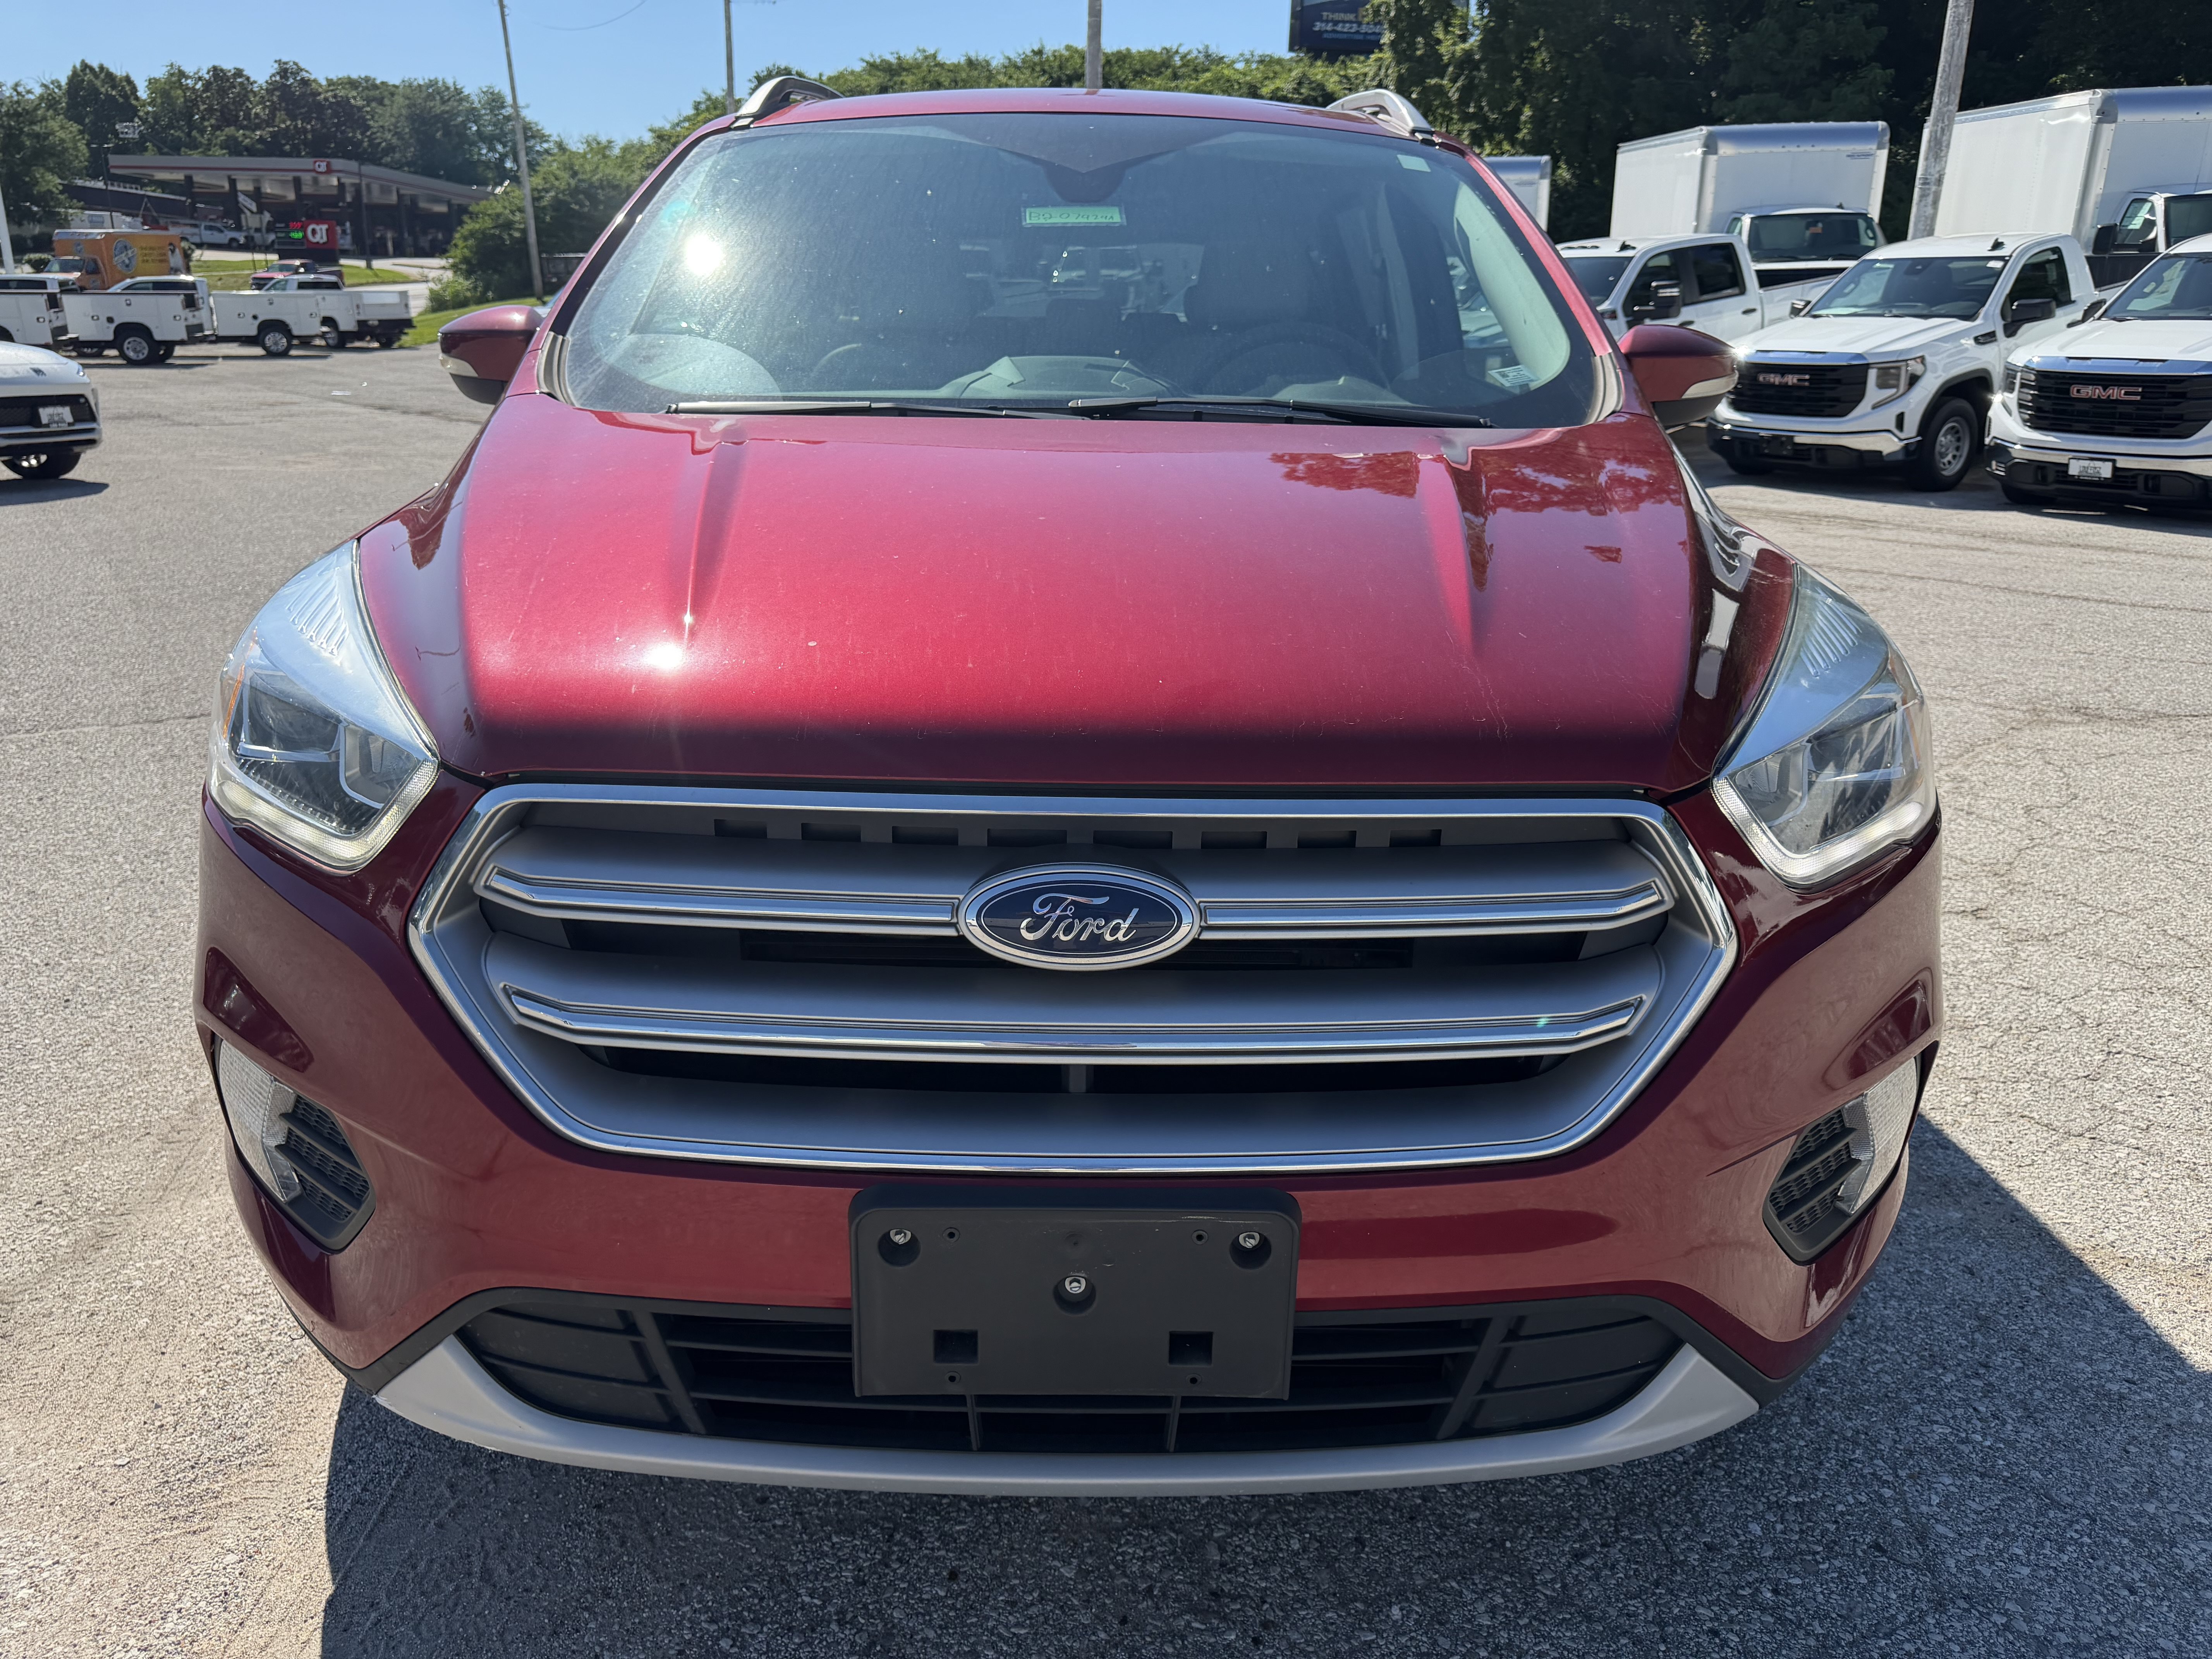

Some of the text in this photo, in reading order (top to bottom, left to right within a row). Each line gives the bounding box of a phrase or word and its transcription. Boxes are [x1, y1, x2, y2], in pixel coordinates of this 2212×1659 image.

[1321, 12, 1356, 21] THINK
[306, 223, 328, 244] QT
[1757, 373, 1809, 386] GMC
[2070, 385, 2142, 400] GMC
[1019, 892, 1140, 942] Ford
